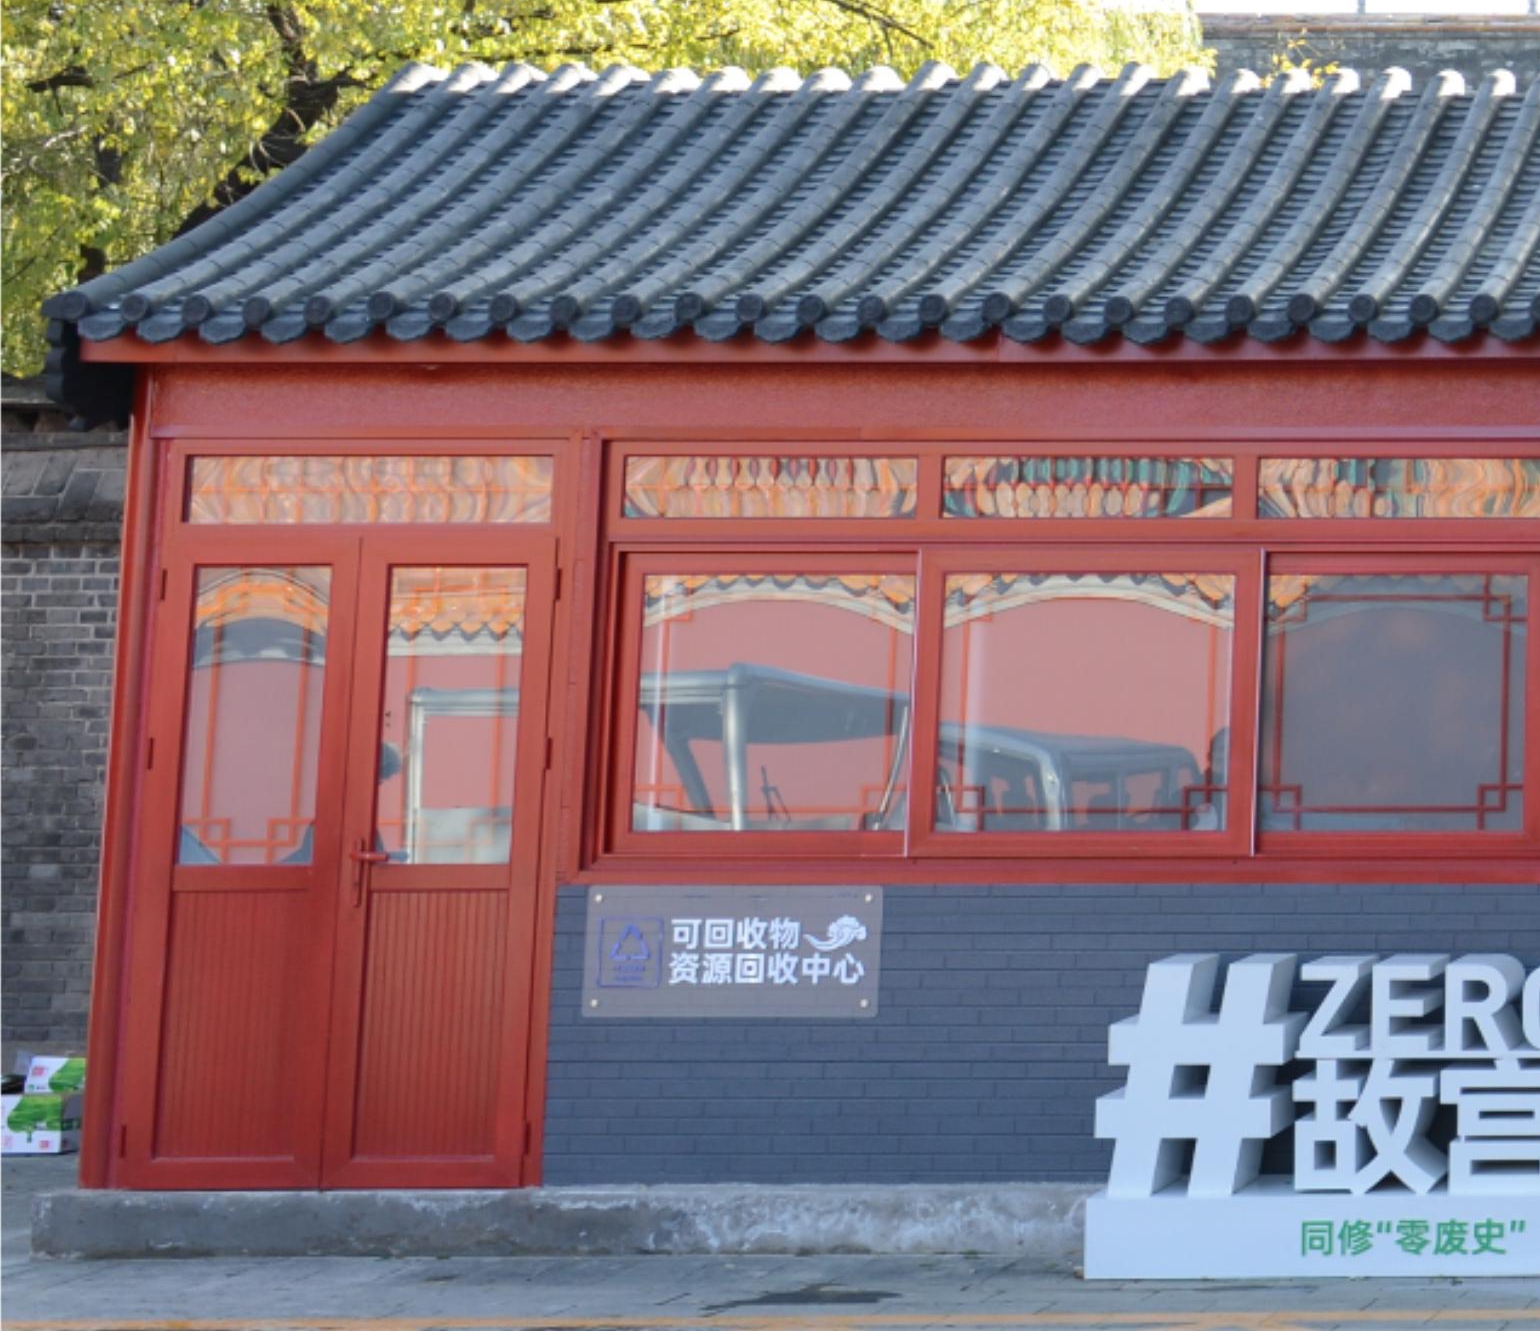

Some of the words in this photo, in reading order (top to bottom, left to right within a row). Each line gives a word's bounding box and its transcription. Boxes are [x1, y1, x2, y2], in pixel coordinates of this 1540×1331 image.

[670, 918, 801, 949] 可回收物
[669, 953, 865, 985] 资源回收中心
